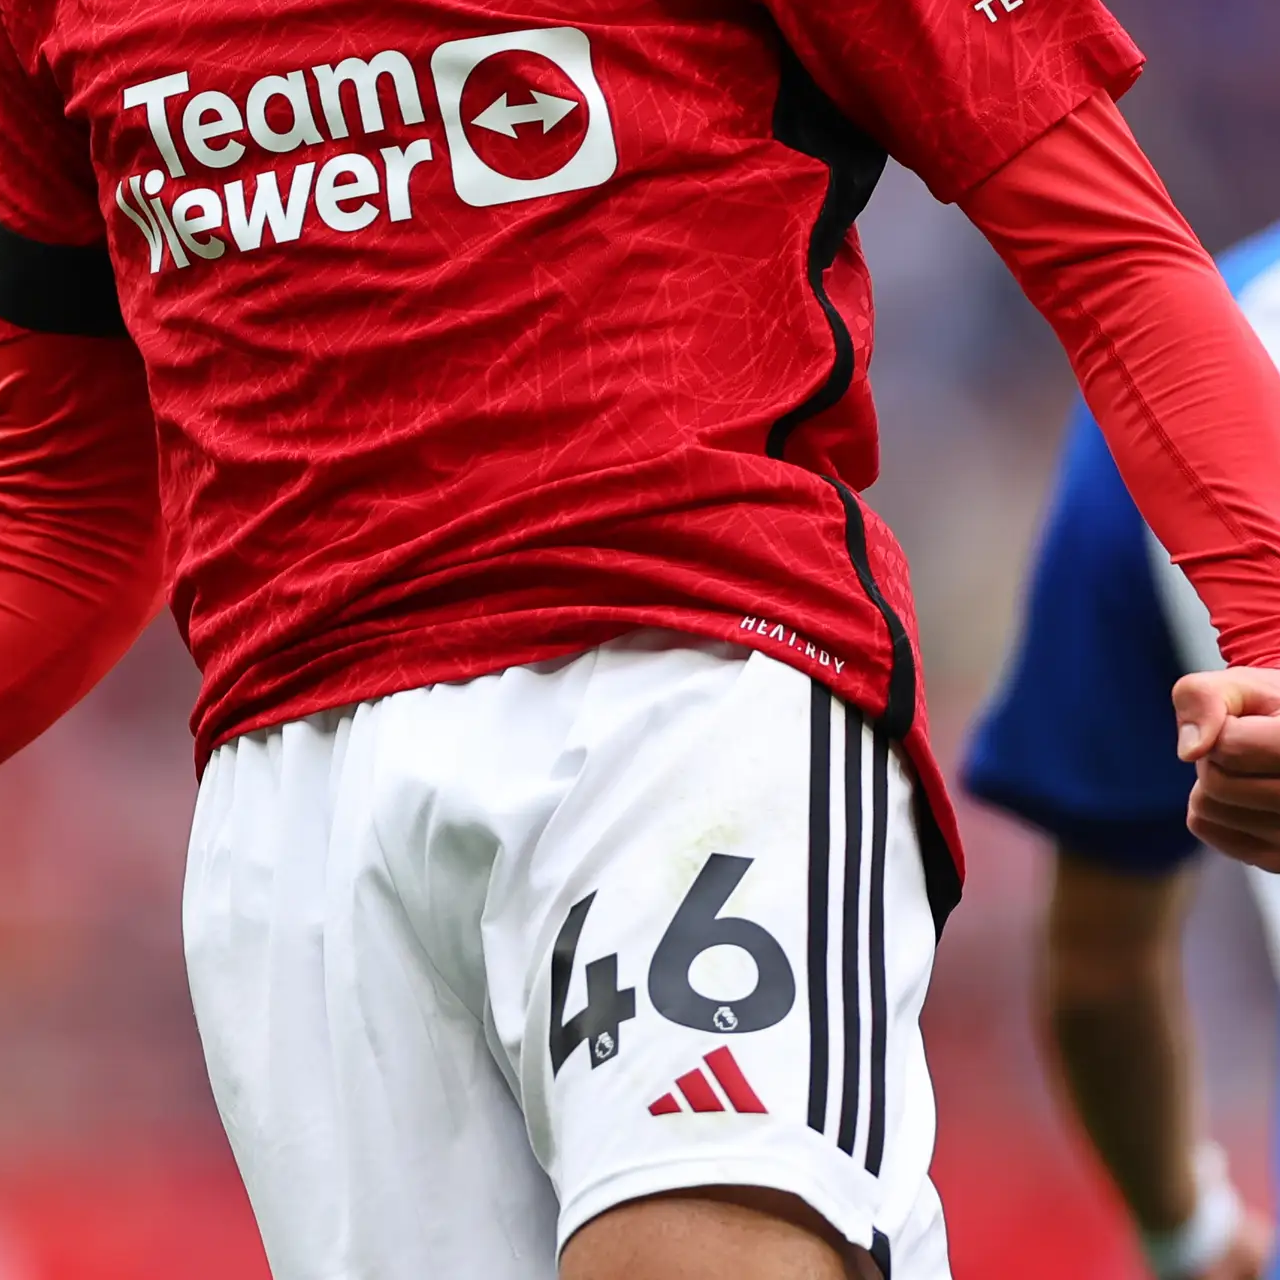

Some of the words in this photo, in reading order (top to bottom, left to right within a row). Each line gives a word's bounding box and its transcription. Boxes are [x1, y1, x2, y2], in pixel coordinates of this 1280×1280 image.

[123, 48, 426, 179] Team
[115, 138, 433, 274] Viewer
[549, 852, 796, 1082] 46
